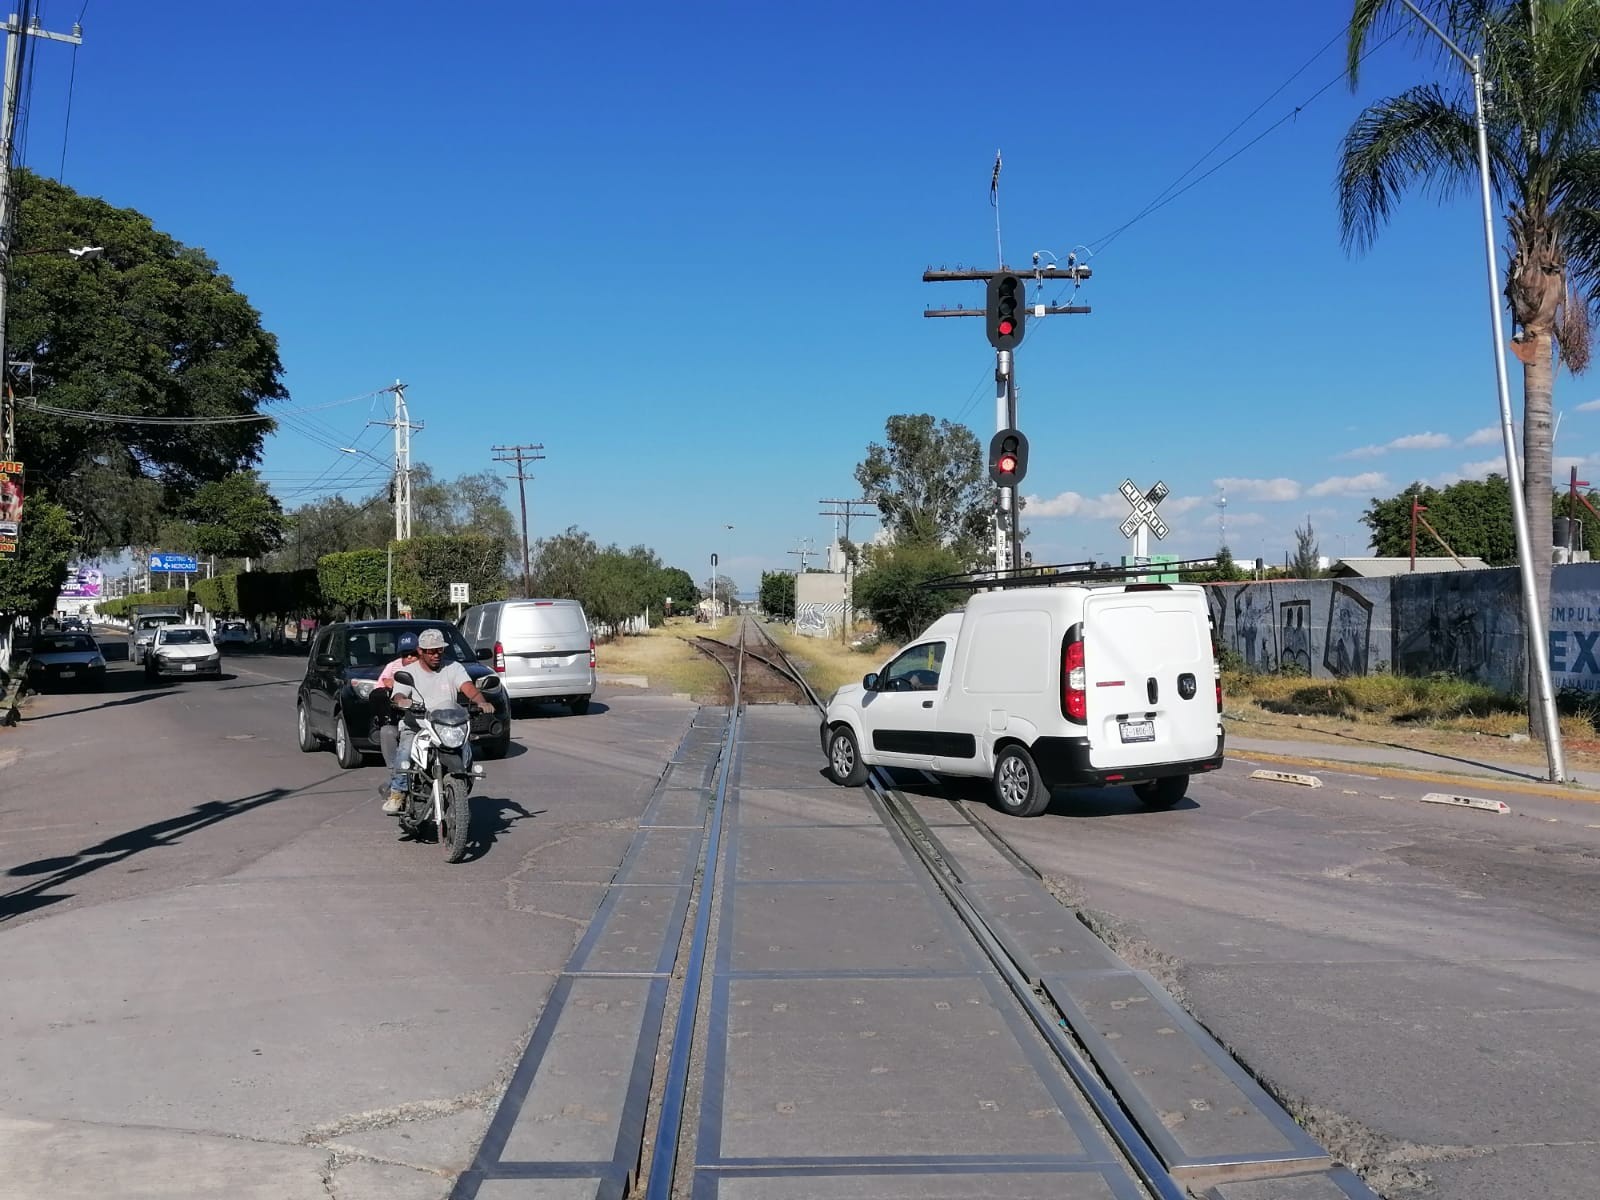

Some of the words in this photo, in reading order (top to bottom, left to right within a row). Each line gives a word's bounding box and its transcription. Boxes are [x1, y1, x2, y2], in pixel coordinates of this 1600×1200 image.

[1122, 482, 1167, 537] CUIDADO
[1146, 484, 1167, 508] TREN
[1551, 607, 1600, 622] IMPUL
[1548, 631, 1600, 674] EX
